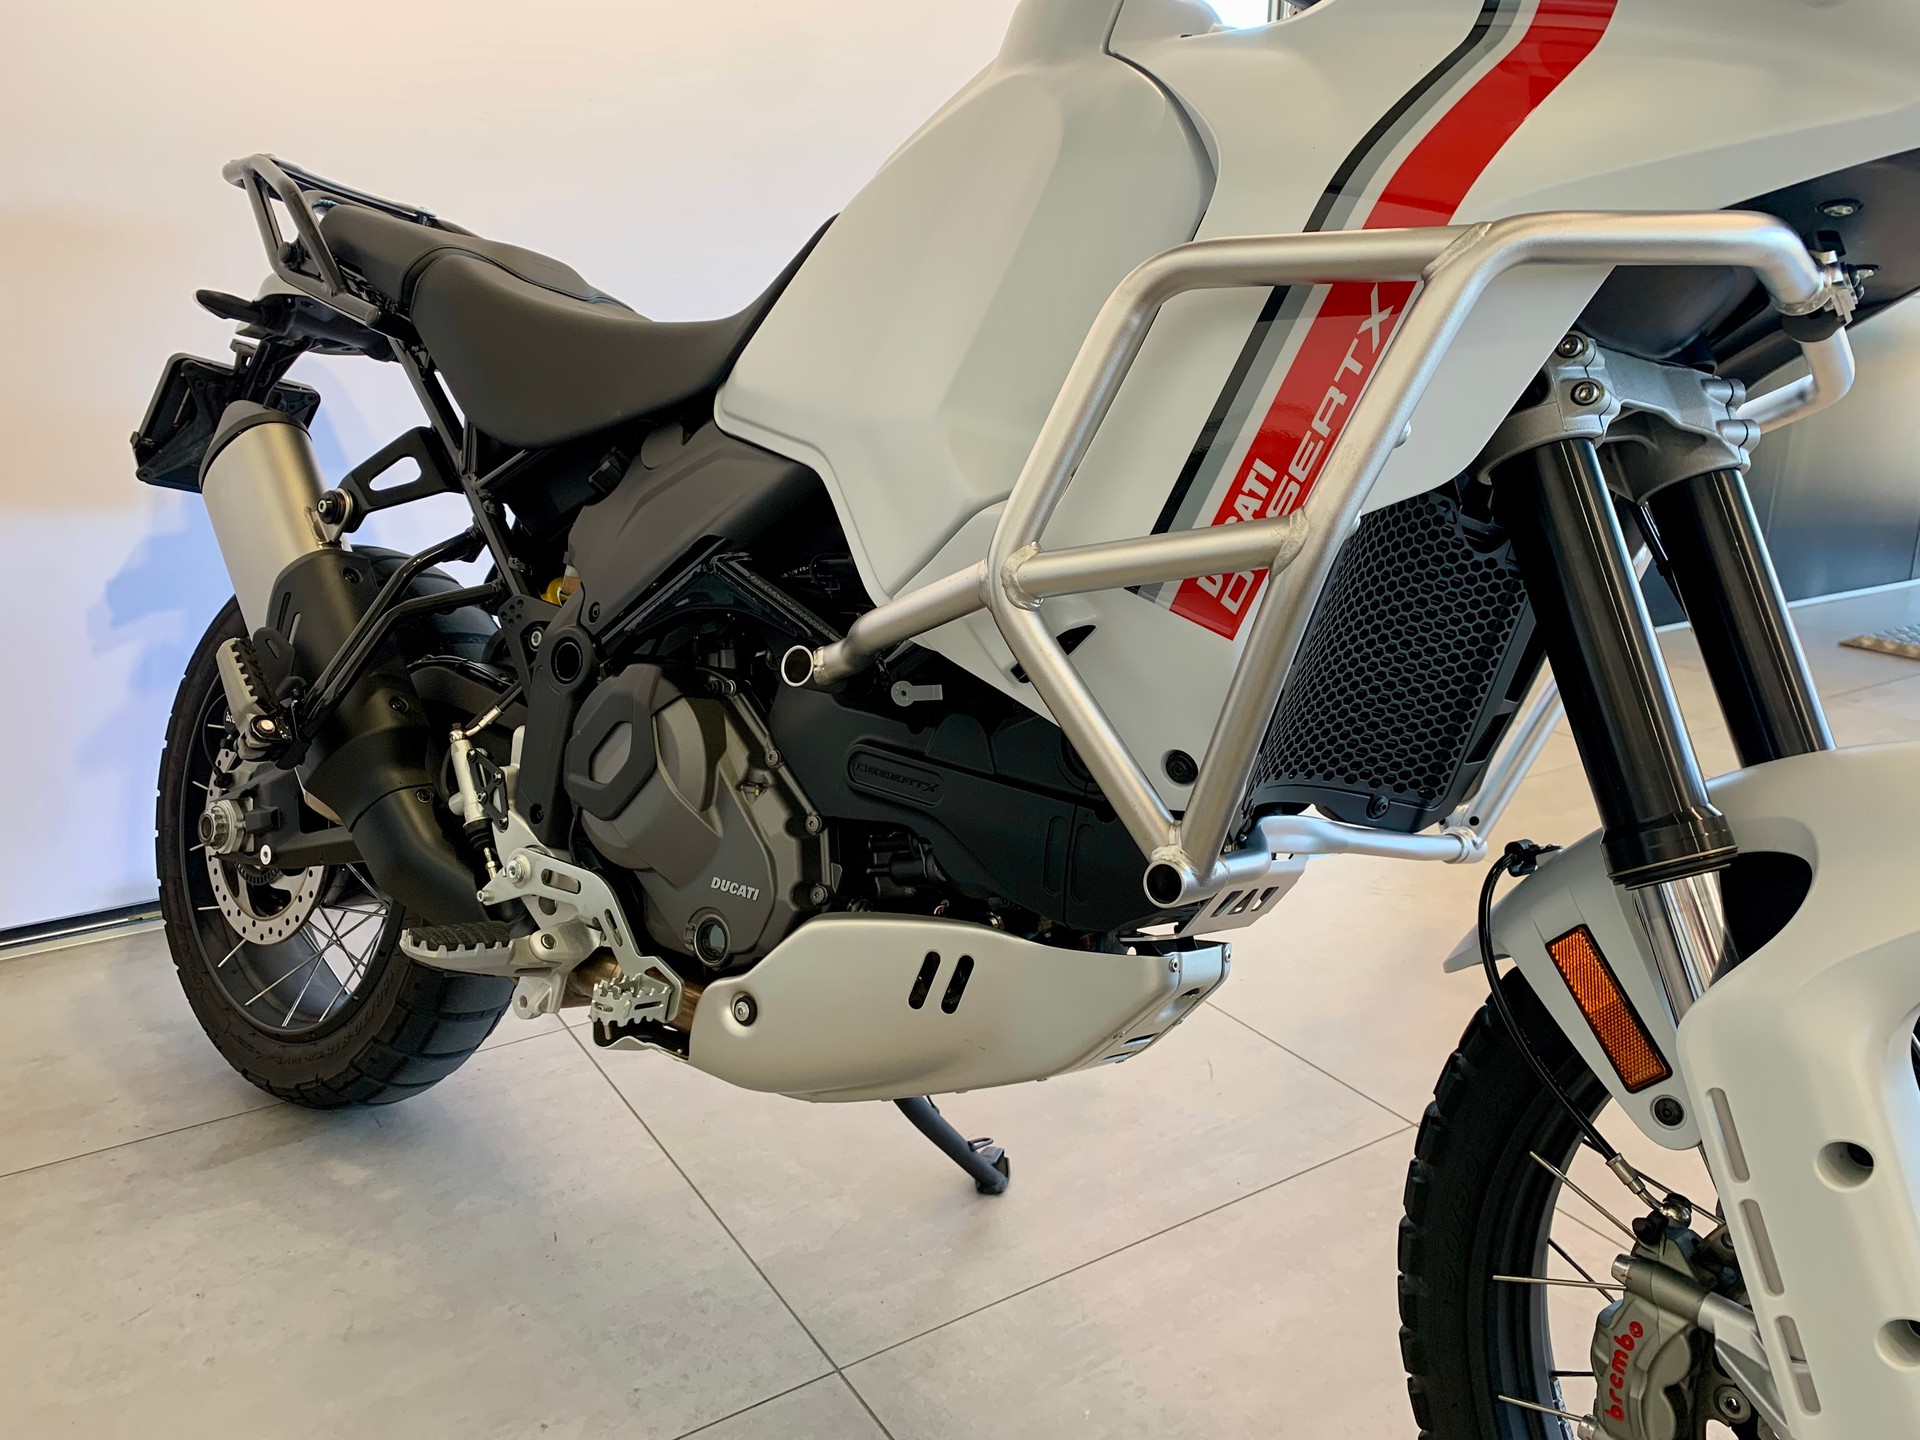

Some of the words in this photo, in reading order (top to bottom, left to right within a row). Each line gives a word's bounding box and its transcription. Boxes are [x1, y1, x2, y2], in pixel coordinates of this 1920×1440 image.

[1220, 282, 1395, 616] DSERTX
[1196, 457, 1278, 599] DATI
[710, 876, 760, 901] DUCATI
[1604, 1320, 1644, 1422] brembo
